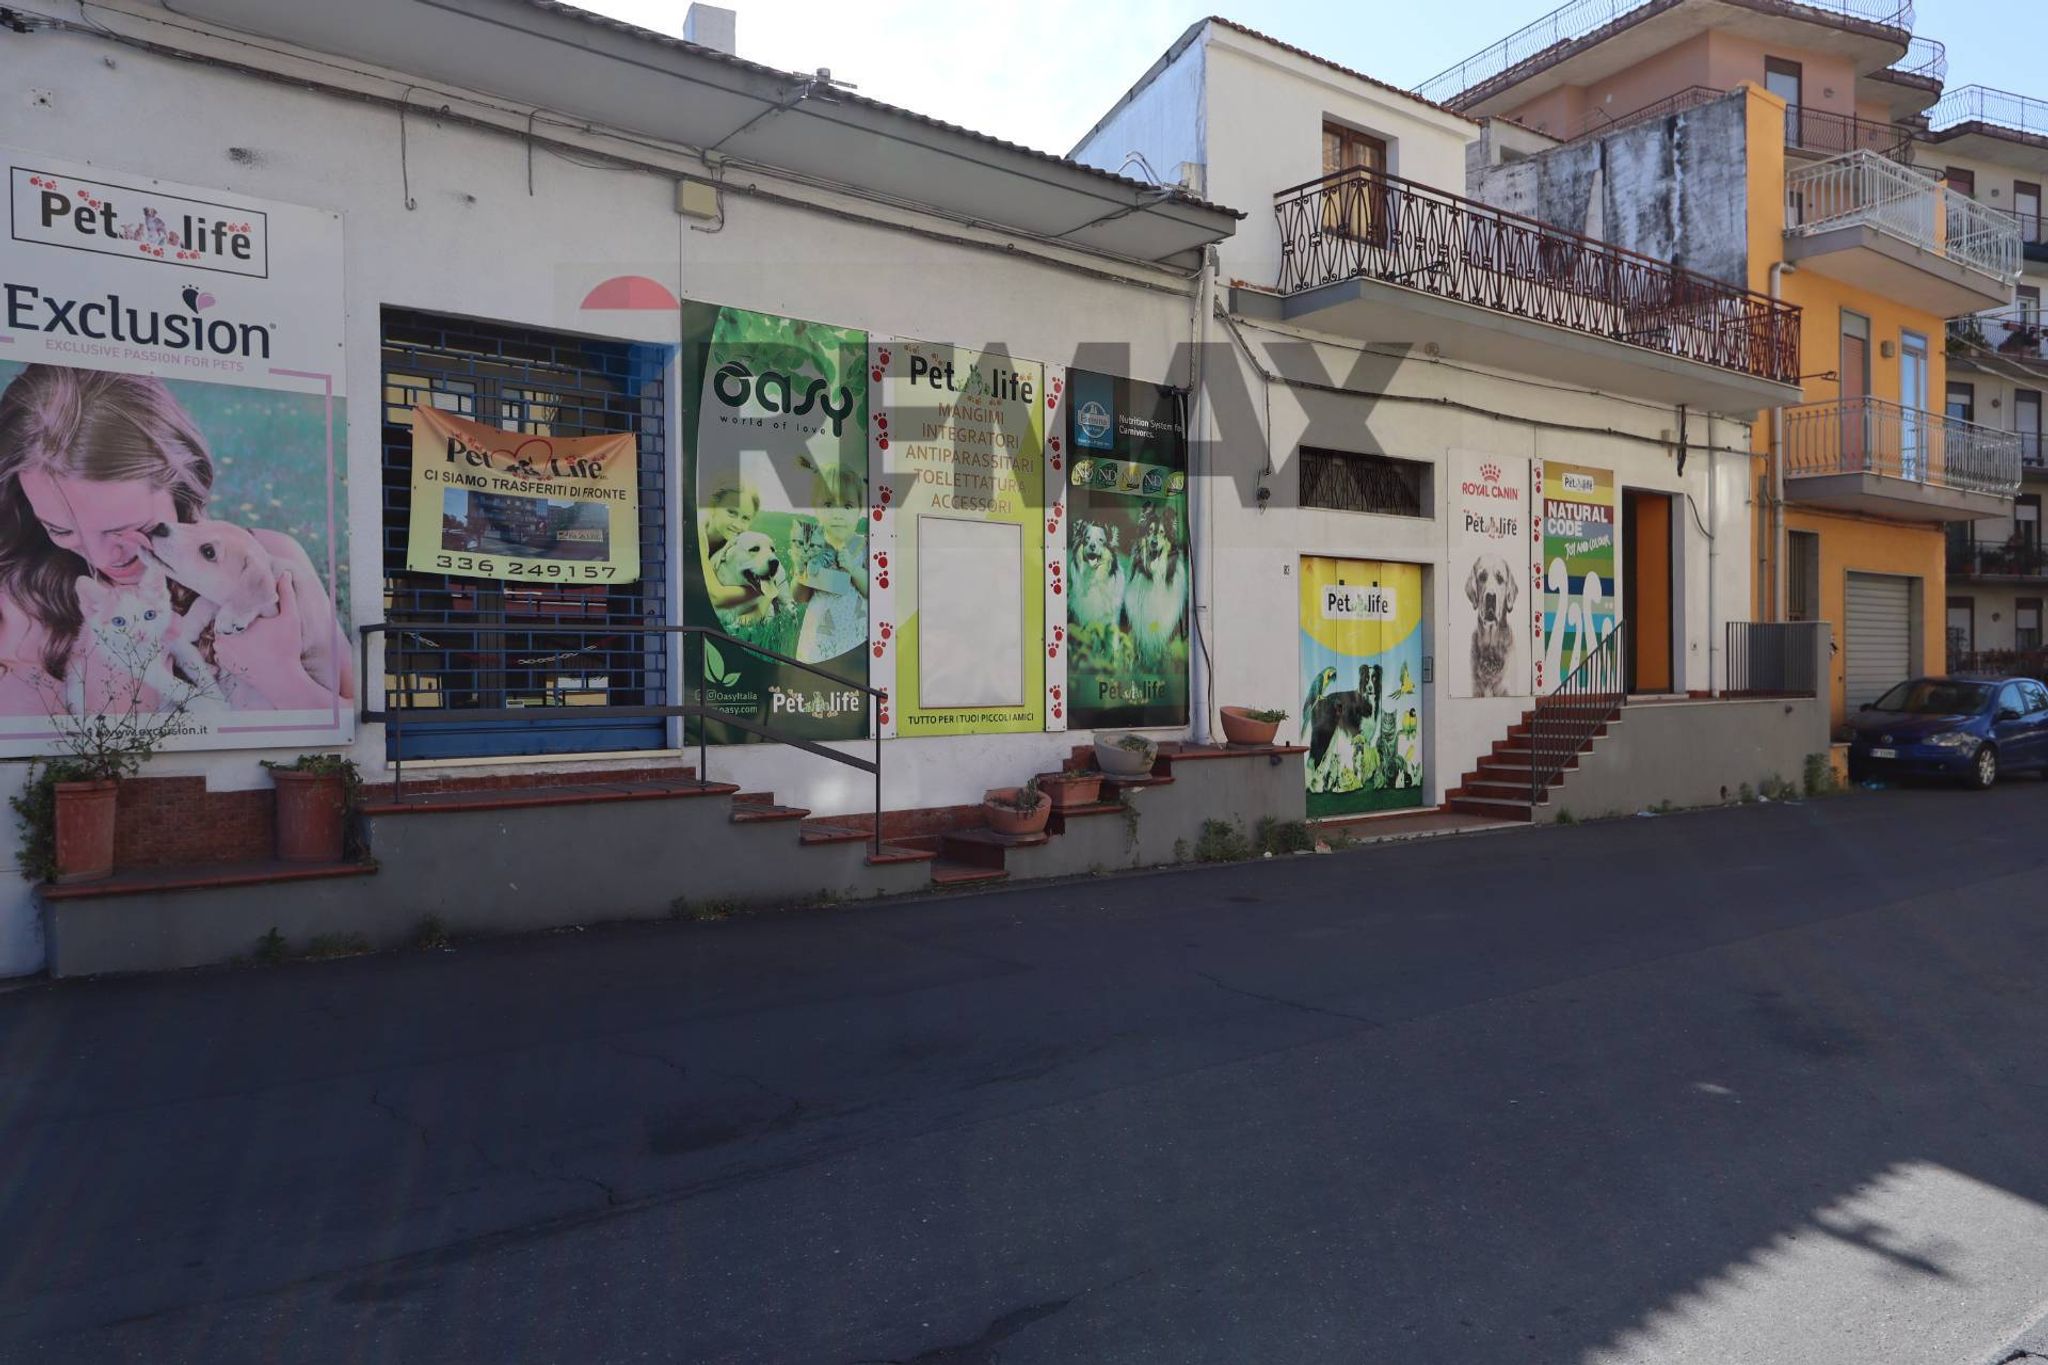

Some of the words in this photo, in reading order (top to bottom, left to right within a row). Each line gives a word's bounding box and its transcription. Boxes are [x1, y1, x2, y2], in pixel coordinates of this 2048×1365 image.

[41, 190, 118, 239] Pet
[183, 215, 251, 260] life
[4, 283, 270, 359] Exclusion
[45, 338, 120, 357] EXCLUSIVE
[124, 350, 181, 365] PASSION
[184, 355, 209, 367] FOR
[213, 359, 244, 371] PETS
[911, 355, 955, 392] Pet
[991, 368, 1033, 404] life
[720, 415, 762, 427] world
[773, 420, 787, 430] of
[796, 425, 825, 435] love
[938, 402, 1004, 425] MANGIMI
[922, 422, 1019, 449] INTEGRATORI
[446, 437, 493, 468] Pet
[551, 458, 602, 479] Life
[905, 445, 1034, 473] ANTIPARASSITARI
[424, 469, 438, 481] CI
[442, 472, 488, 489] SIAMO
[491, 478, 567, 497] TRASFERITI
[569, 486, 581, 497] DI
[582, 487, 627, 500] FRONTE
[914, 468, 1025, 494] TOELETTATURA
[1462, 482, 1490, 497] ROYAL
[1492, 487, 1518, 500] CANIN
[1564, 477, 1577, 488] Pet
[931, 493, 1012, 514] ACCESSORI
[1547, 501, 1609, 523] NATURAL
[1465, 515, 1484, 533] Pet
[1500, 519, 1517, 536] life
[1547, 519, 1583, 536] CODE
[436, 555, 494, 573] 336
[508, 562, 617, 578] 249157
[1328, 593, 1350, 612] Pet
[1368, 594, 1388, 613] life
[1099, 681, 1121, 700] Pet
[1142, 680, 1166, 699] life
[773, 693, 804, 714] Pet
[831, 691, 859, 712] life
[908, 715, 937, 725] TUTTO
[938, 714, 954, 724] PER
[959, 714, 979, 723] TUOI
[1013, 712, 1034, 722] AMICI
